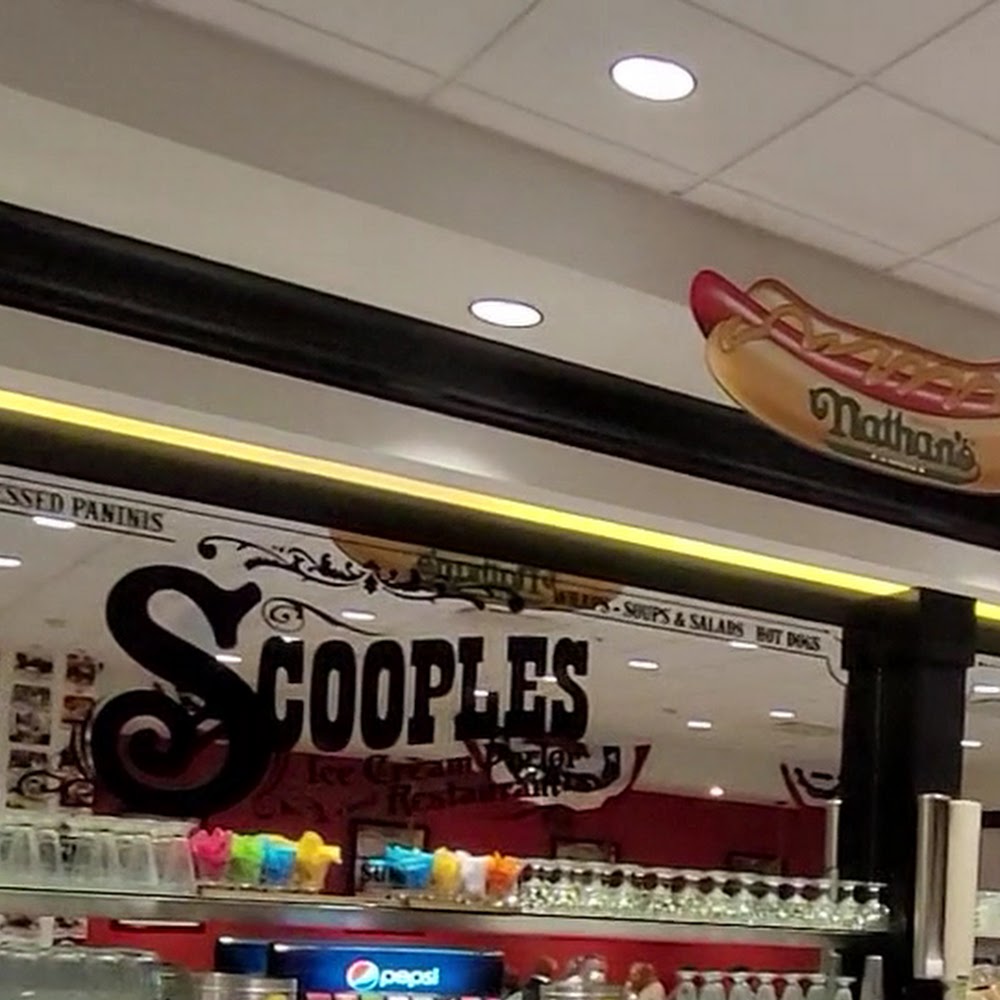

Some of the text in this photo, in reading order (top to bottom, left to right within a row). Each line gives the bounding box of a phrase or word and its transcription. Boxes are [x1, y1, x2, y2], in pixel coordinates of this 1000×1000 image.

[809, 387, 975, 471] Nathan's
[72, 496, 164, 533] PANINIS
[622, 600, 671, 626] SOUPS
[674, 612, 686, 628] &
[689, 613, 745, 638] SALADS
[755, 625, 784, 646] HOT
[786, 631, 822, 652] DOGS
[379, 966, 440, 988] pepsi
